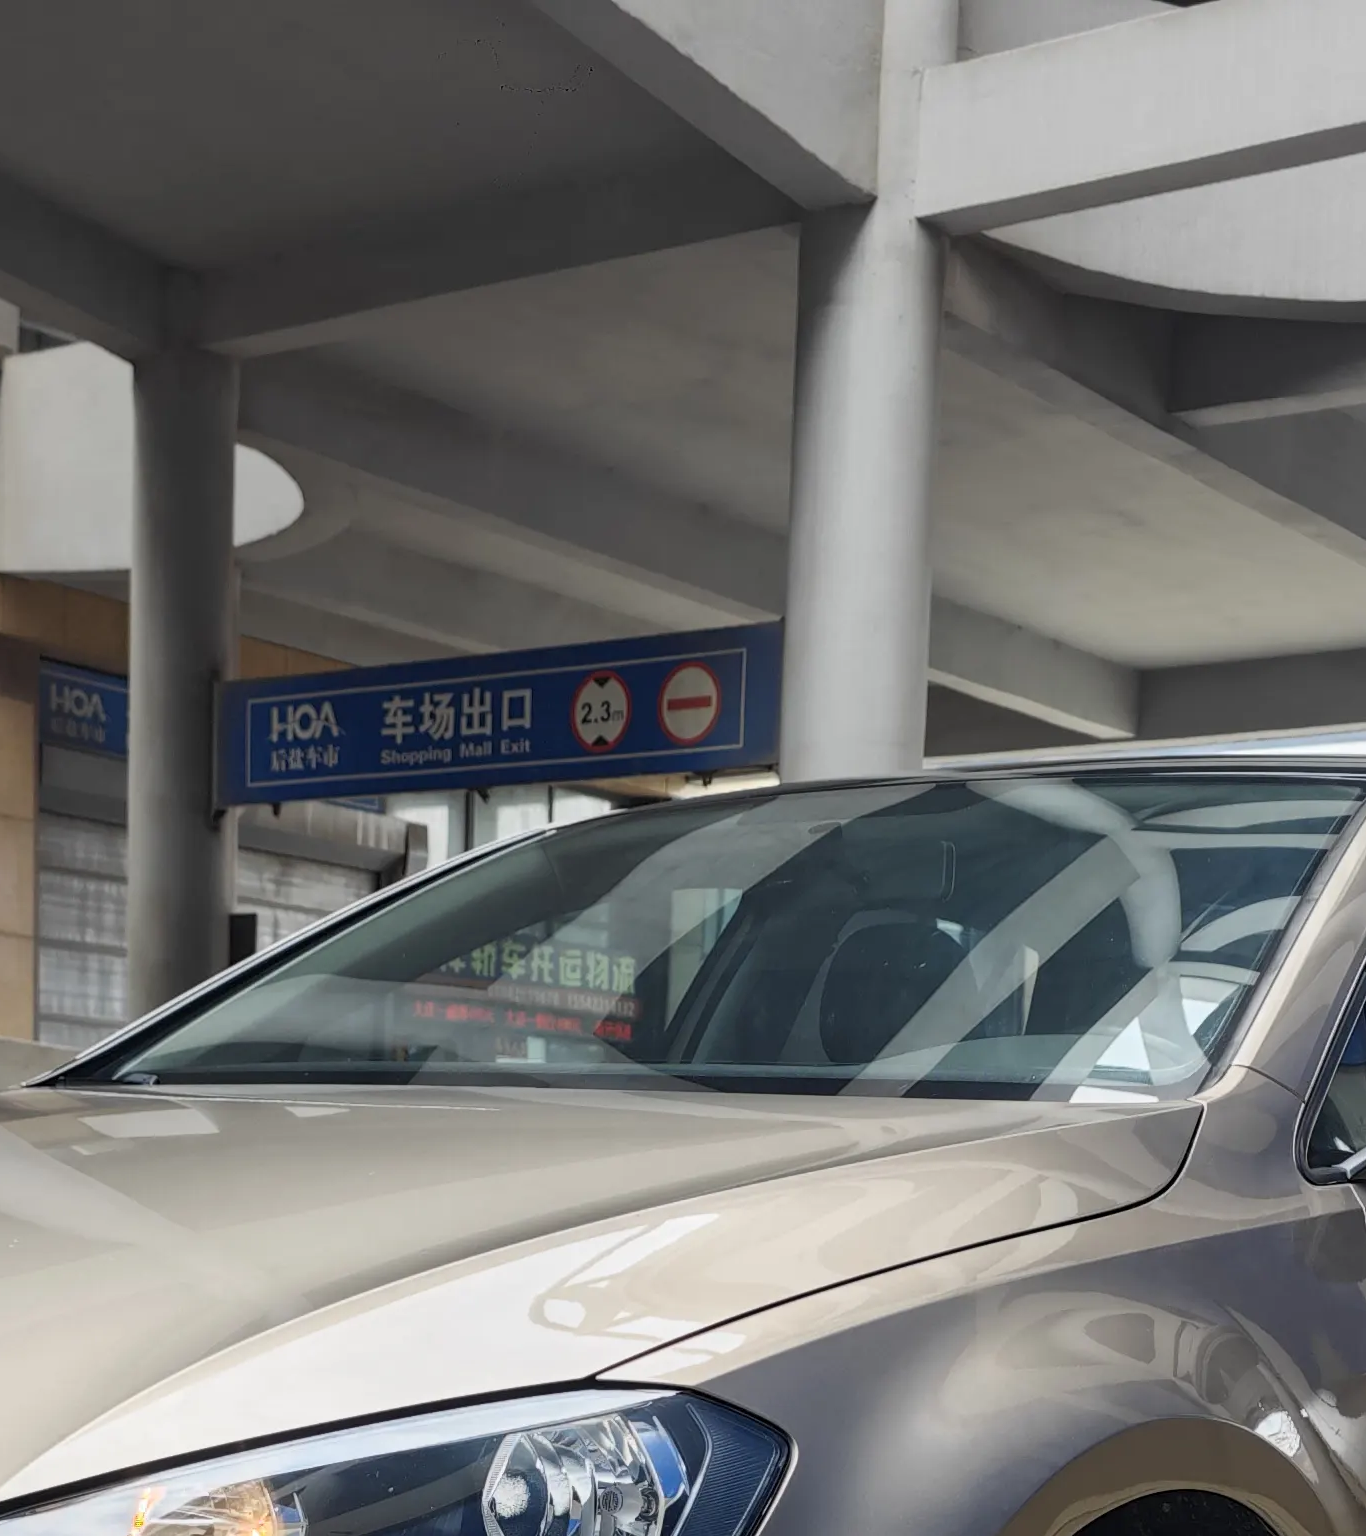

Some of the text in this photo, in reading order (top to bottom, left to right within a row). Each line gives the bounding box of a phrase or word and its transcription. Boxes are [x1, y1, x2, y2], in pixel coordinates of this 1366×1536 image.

[50, 683, 107, 722] HOA
[268, 701, 341, 743] HOA
[380, 687, 533, 745] 车场出口
[380, 738, 532, 766] Shopping Mall Exit
